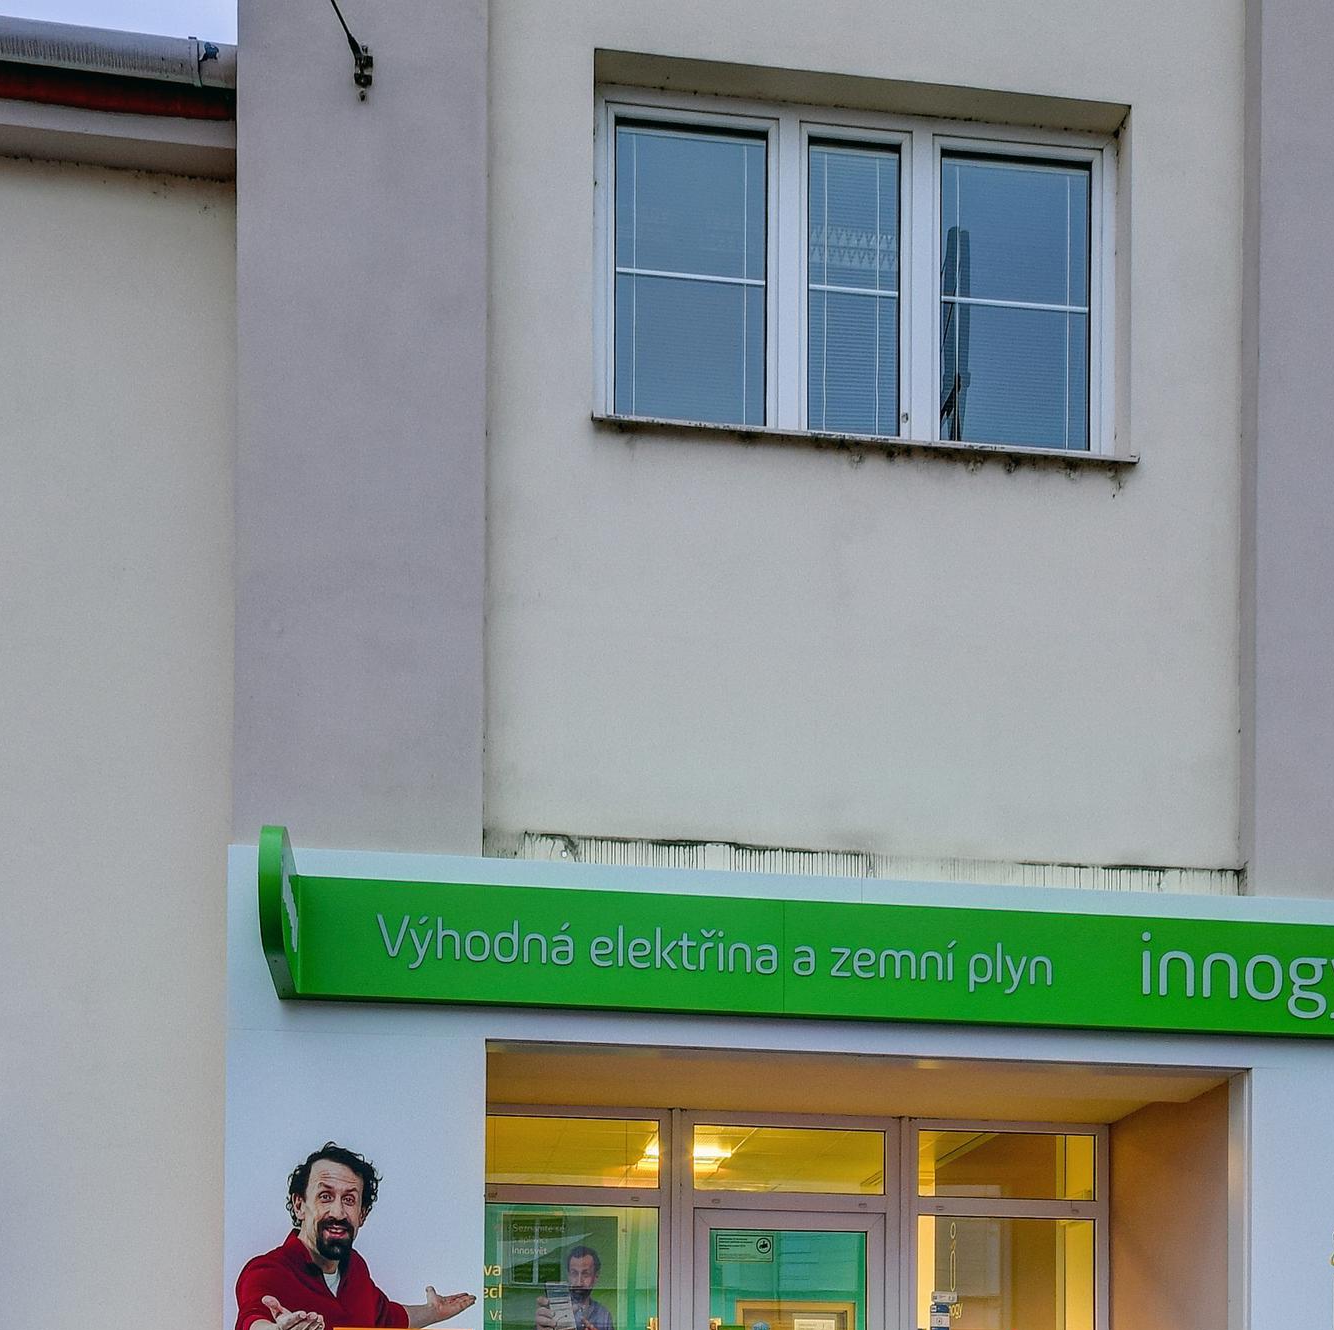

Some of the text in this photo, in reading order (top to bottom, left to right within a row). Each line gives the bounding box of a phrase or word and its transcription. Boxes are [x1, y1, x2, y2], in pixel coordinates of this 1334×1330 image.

[376, 912, 1053, 995] Výhodná elektřina a zemní plyn
